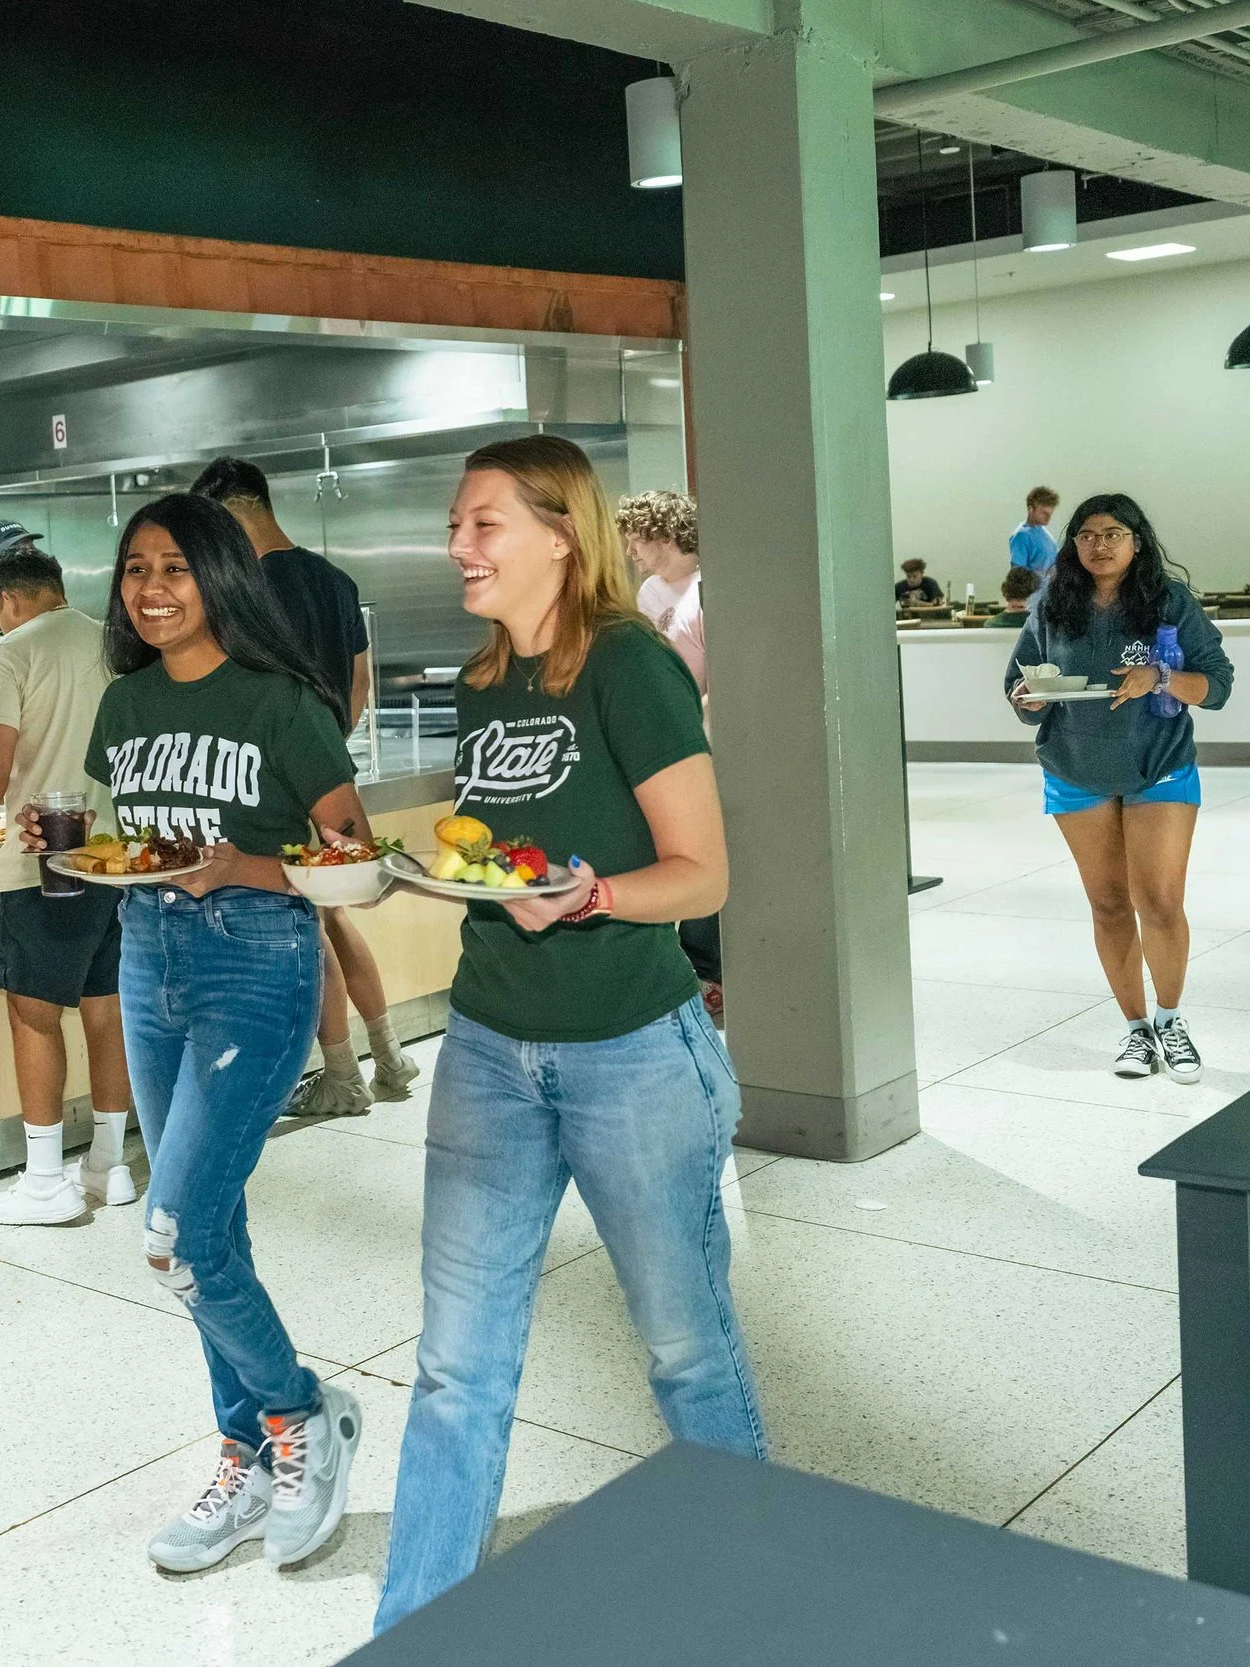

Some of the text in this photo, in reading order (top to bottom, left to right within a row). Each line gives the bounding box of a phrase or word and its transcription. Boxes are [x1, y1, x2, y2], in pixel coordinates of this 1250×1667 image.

[55, 421, 65, 443] 6
[516, 715, 557, 728] COLORADO
[456, 720, 564, 803] State
[483, 793, 533, 805] UNIVERSITY
